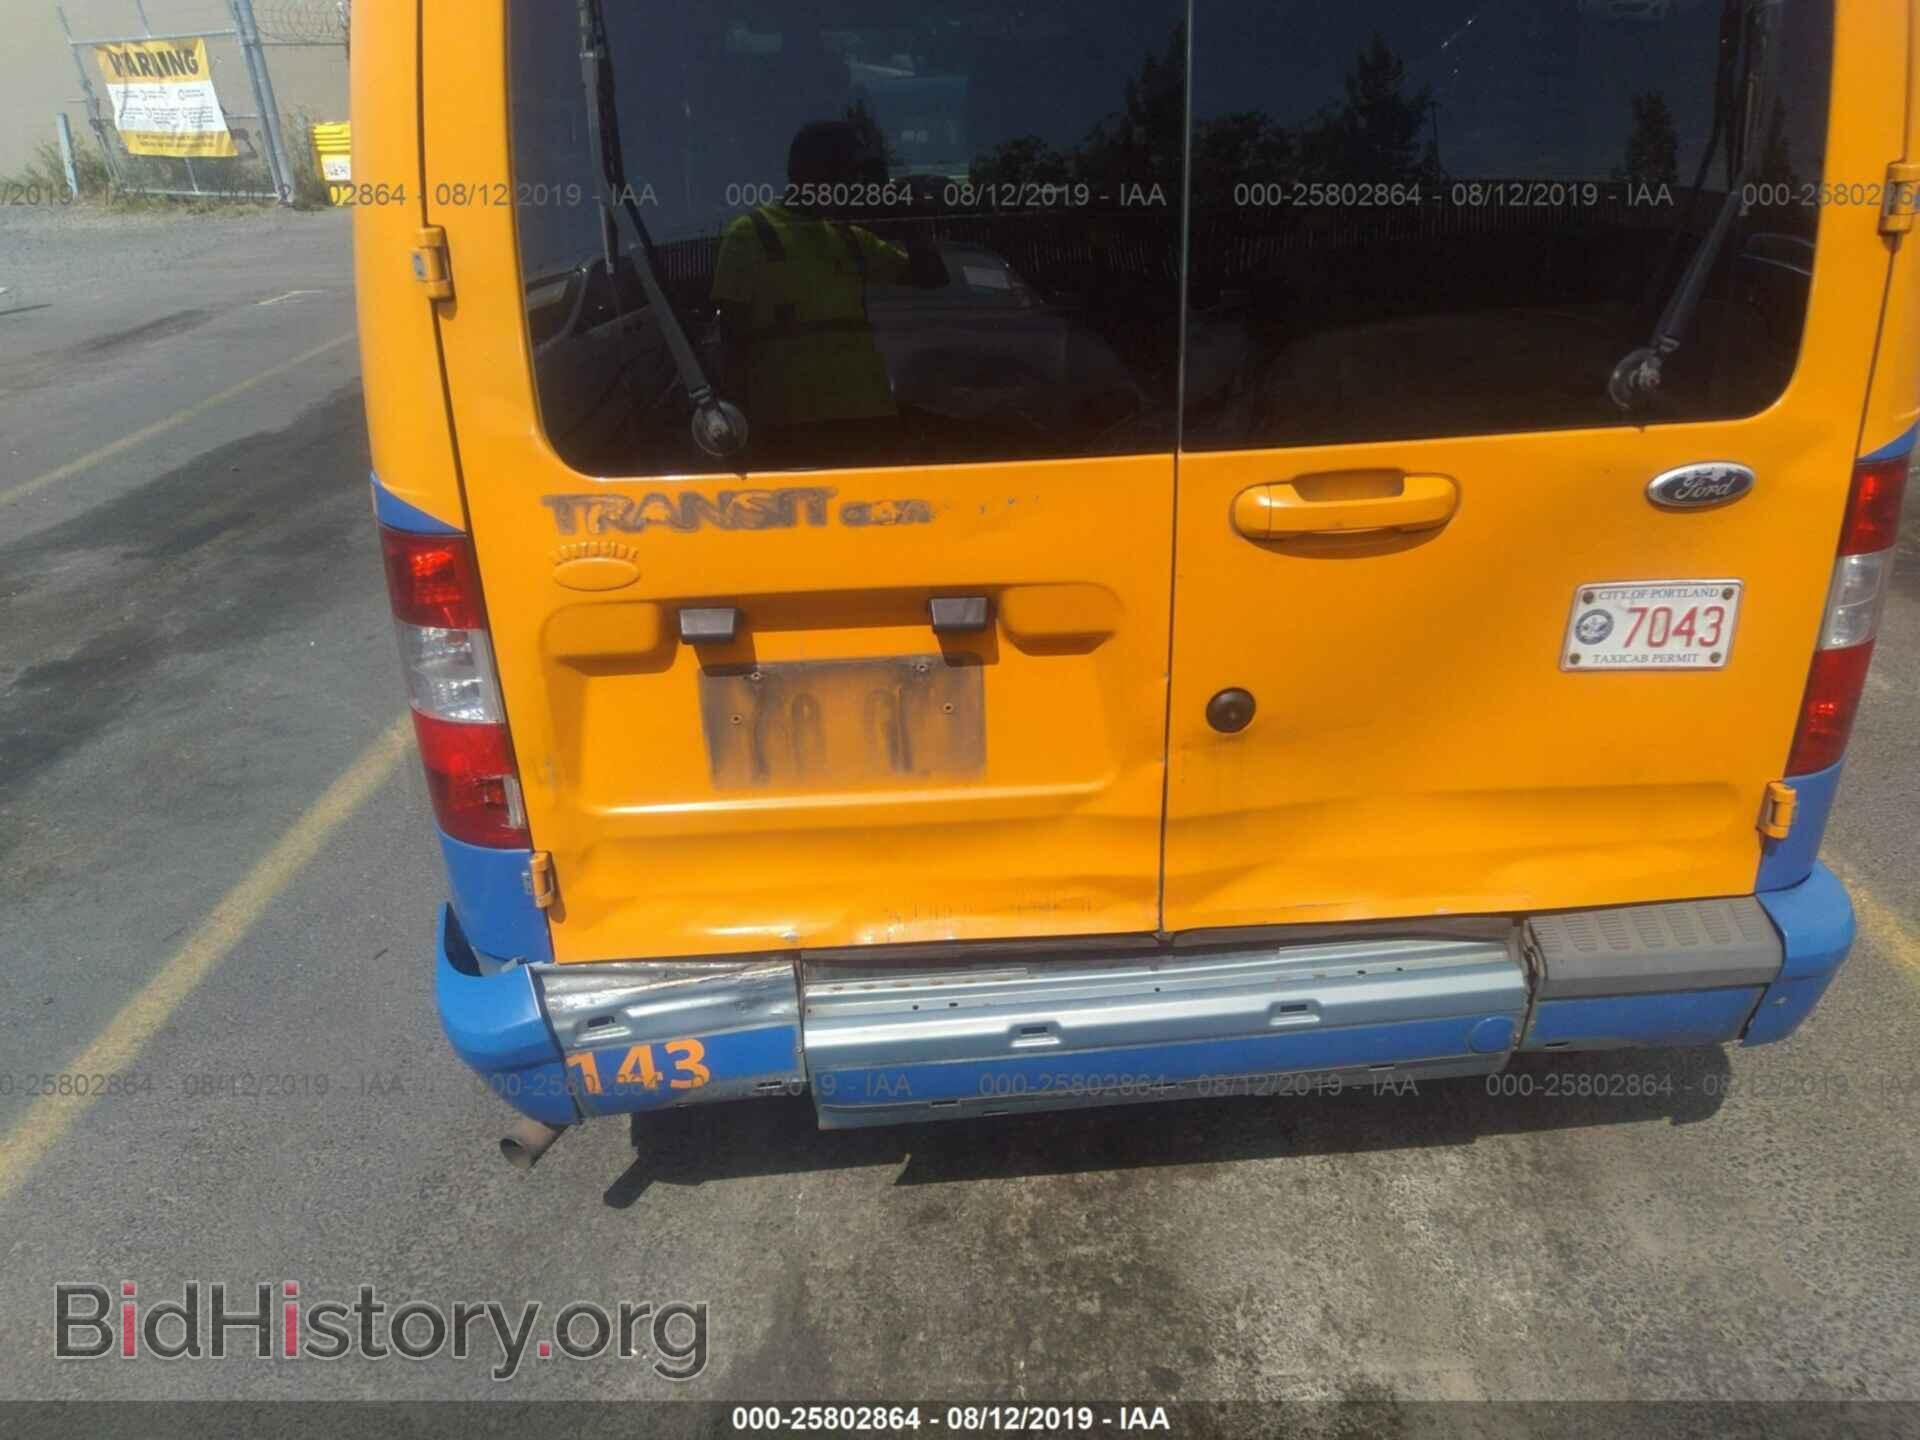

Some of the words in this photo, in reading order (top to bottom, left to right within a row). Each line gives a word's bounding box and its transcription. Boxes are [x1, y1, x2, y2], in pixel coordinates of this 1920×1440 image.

[1674, 475, 1737, 499] Ford
[540, 487, 838, 535] TRANSIT
[1598, 588, 1627, 600] CITY
[1629, 588, 1644, 600] OF
[1645, 587, 1720, 599] PORTLAND
[1623, 606, 1725, 649] 7043
[1592, 654, 1649, 664] TAXICAB
[1652, 653, 1699, 664] PERMIT
[566, 1038, 711, 1095] 143
